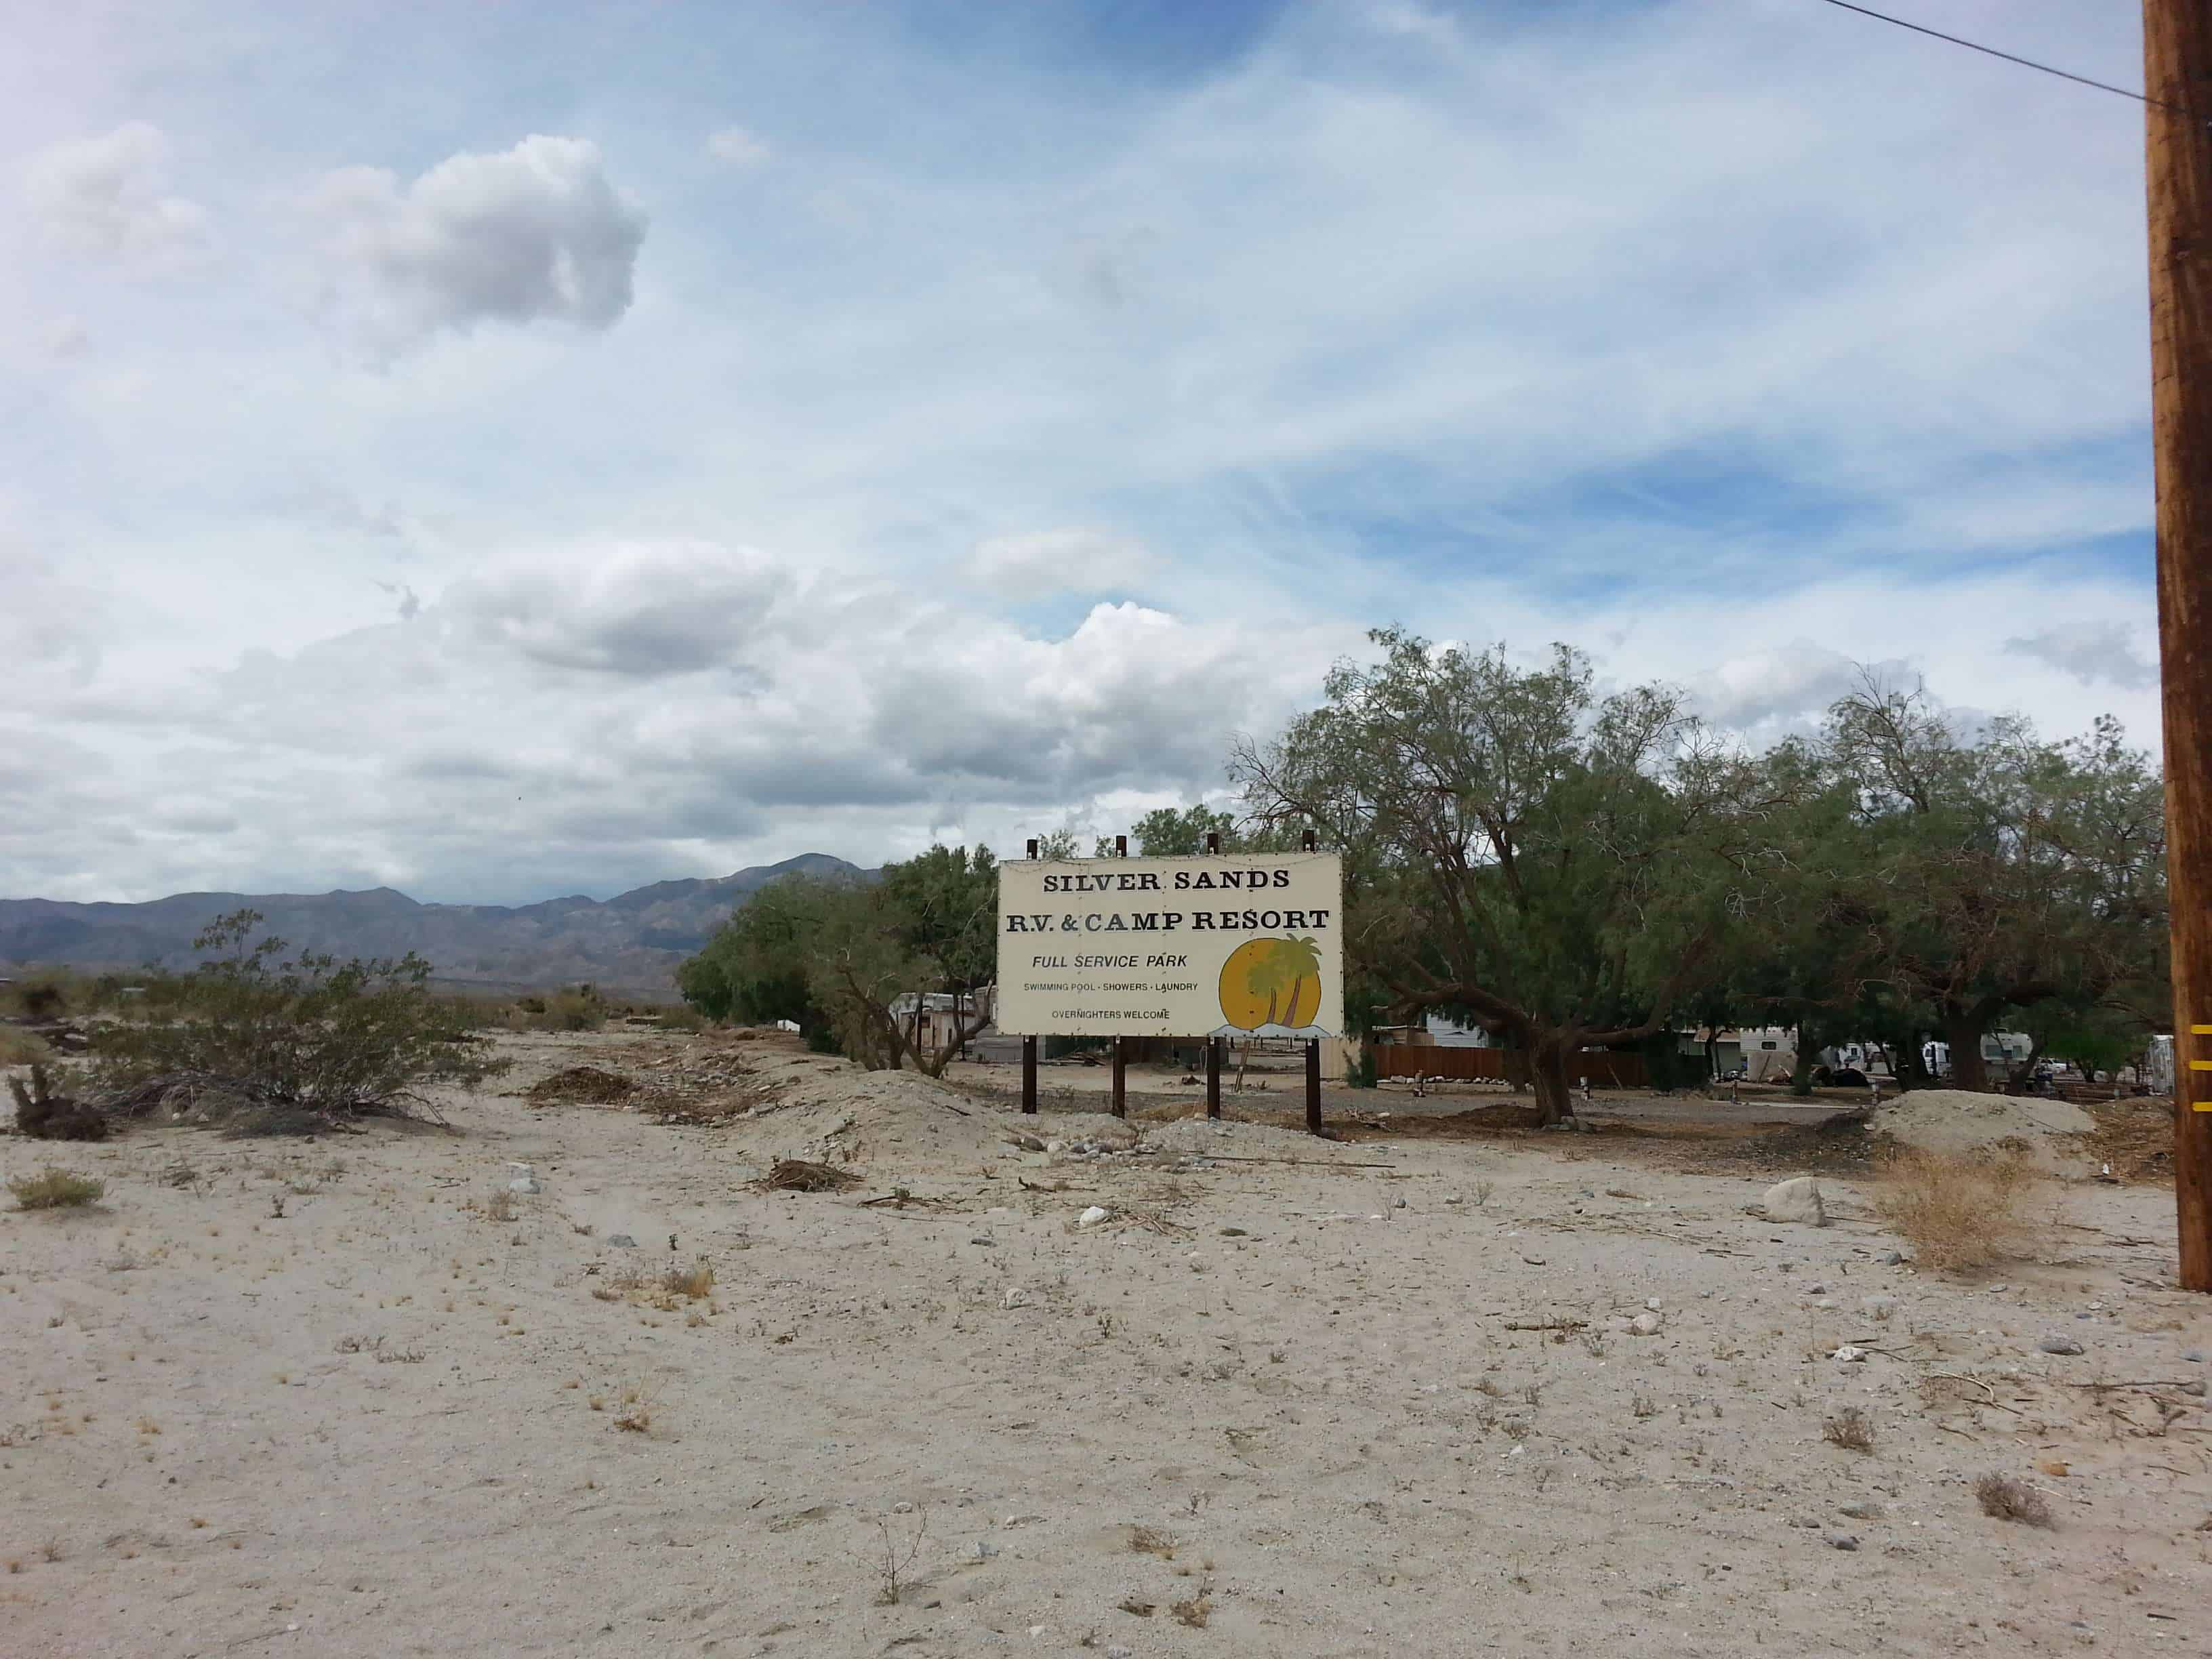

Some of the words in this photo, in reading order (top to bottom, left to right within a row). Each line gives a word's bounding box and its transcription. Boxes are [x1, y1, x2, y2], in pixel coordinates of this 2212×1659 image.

[1044, 874, 1160, 893] SILVER
[1174, 869, 1290, 889] SANDS
[1061, 914, 1078, 932] &
[1085, 912, 1183, 932] CAMP
[1191, 909, 1330, 930] RESORT
[1032, 956, 1067, 968] FULL
[1074, 955, 1139, 968] SERVICE
[1146, 954, 1188, 967] PARK
[1024, 983, 1069, 991] SWIMMING
[1071, 983, 1095, 991] POOL
[1103, 982, 1148, 991] SHOWERS
[1155, 982, 1198, 991] LAUNDRY
[1052, 1010, 1121, 1020] OVERNIGHTERS
[1123, 1010, 1170, 1019] WELCOME
